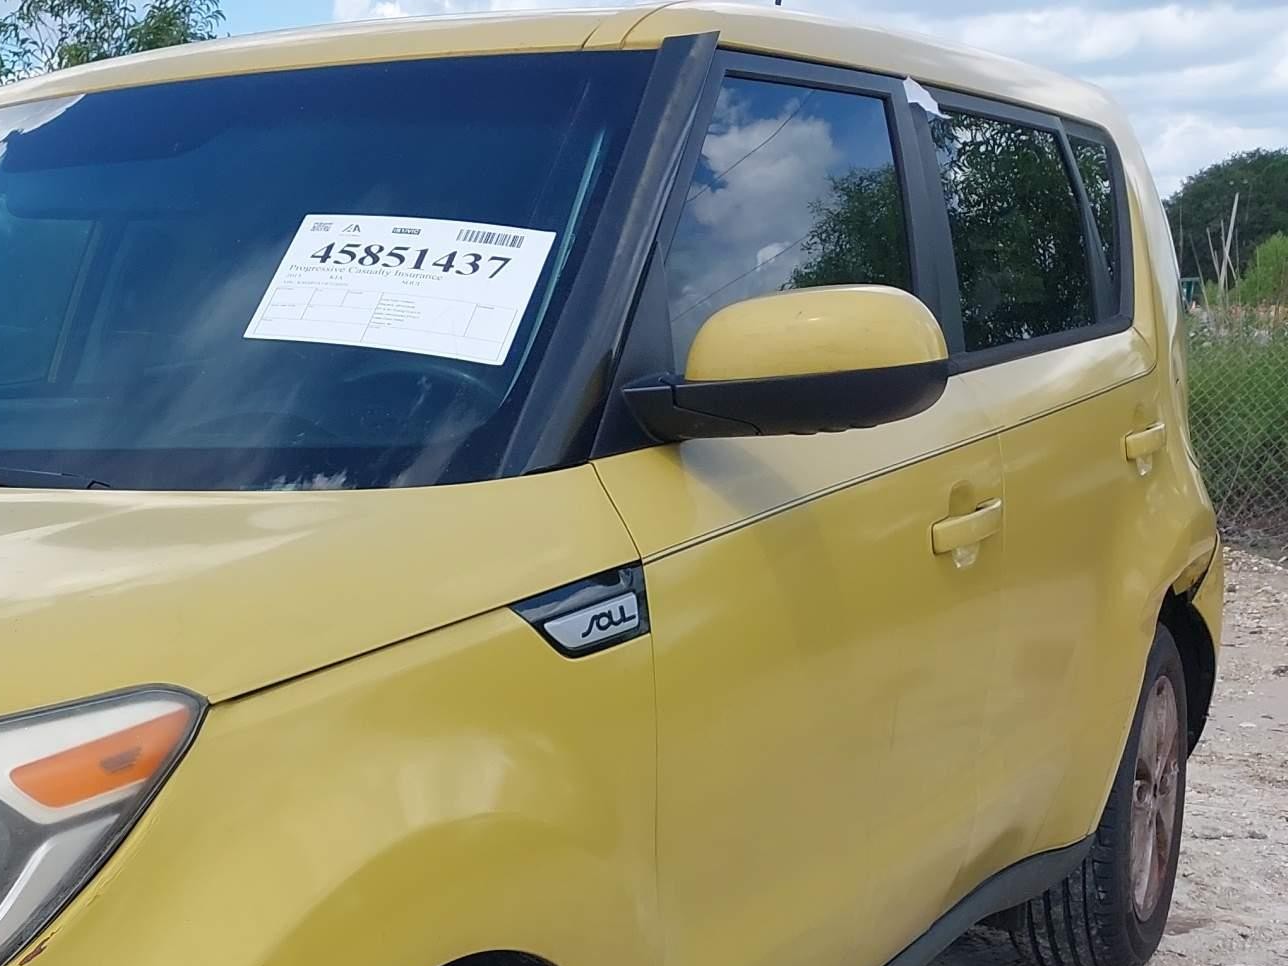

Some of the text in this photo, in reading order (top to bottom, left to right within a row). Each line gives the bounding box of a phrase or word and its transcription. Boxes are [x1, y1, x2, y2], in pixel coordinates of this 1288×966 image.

[289, 264, 444, 281] Progressive Casualty Insurance
[310, 241, 512, 280] 45851437
[581, 605, 637, 638] SOUL
